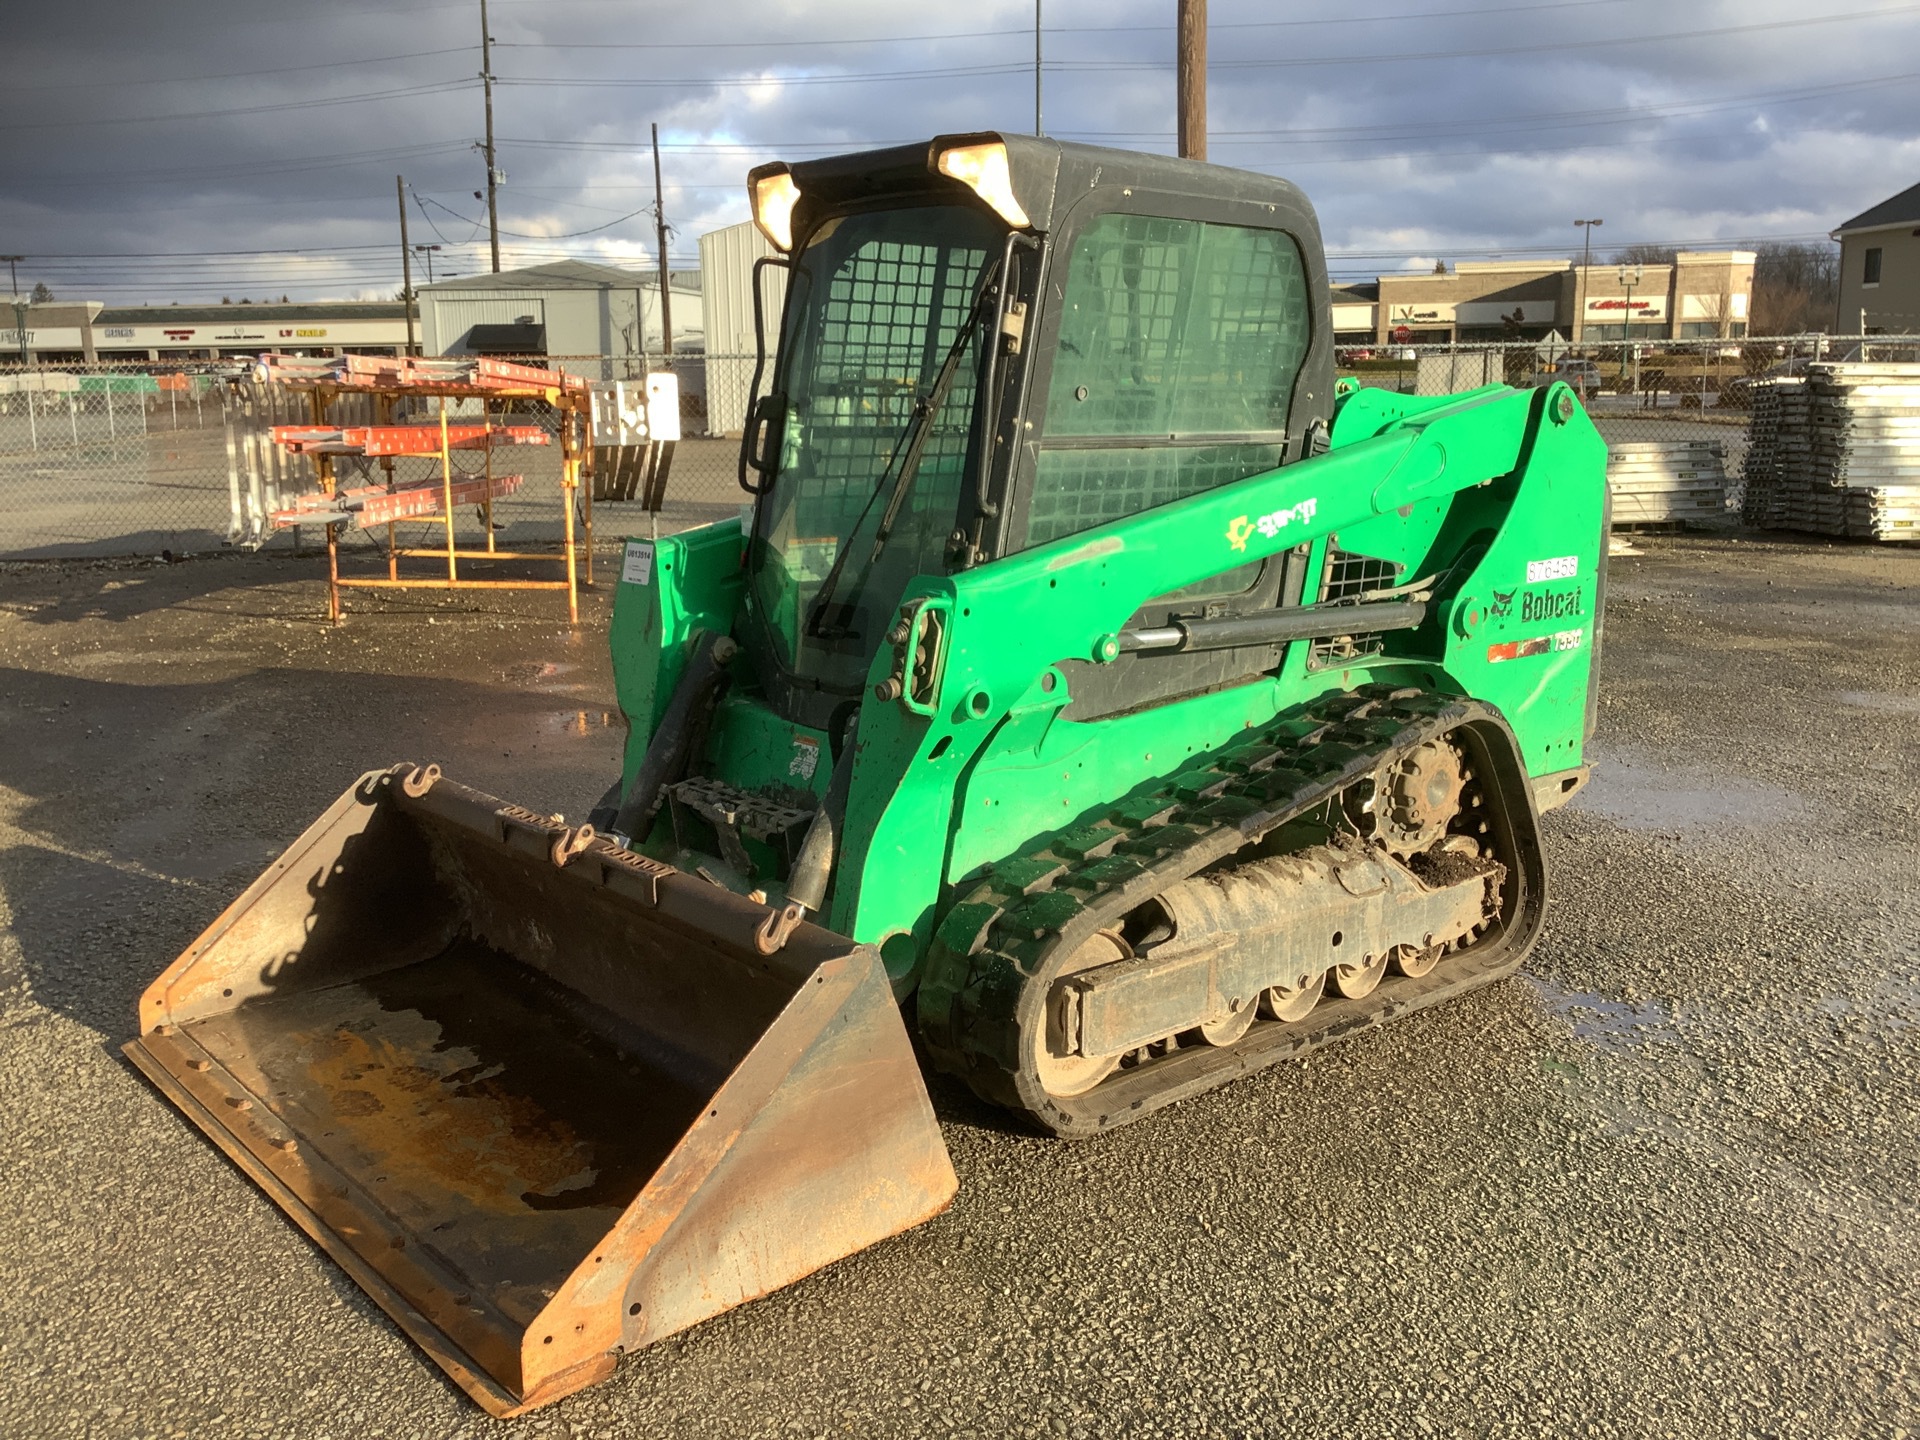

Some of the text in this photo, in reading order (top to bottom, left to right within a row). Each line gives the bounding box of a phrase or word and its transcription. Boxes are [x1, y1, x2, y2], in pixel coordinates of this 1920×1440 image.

[296, 328, 327, 338] NAILS
[1395, 330, 1410, 338] STOP
[1528, 558, 1576, 581] 876458
[1521, 586, 1582, 623] Bobcat
